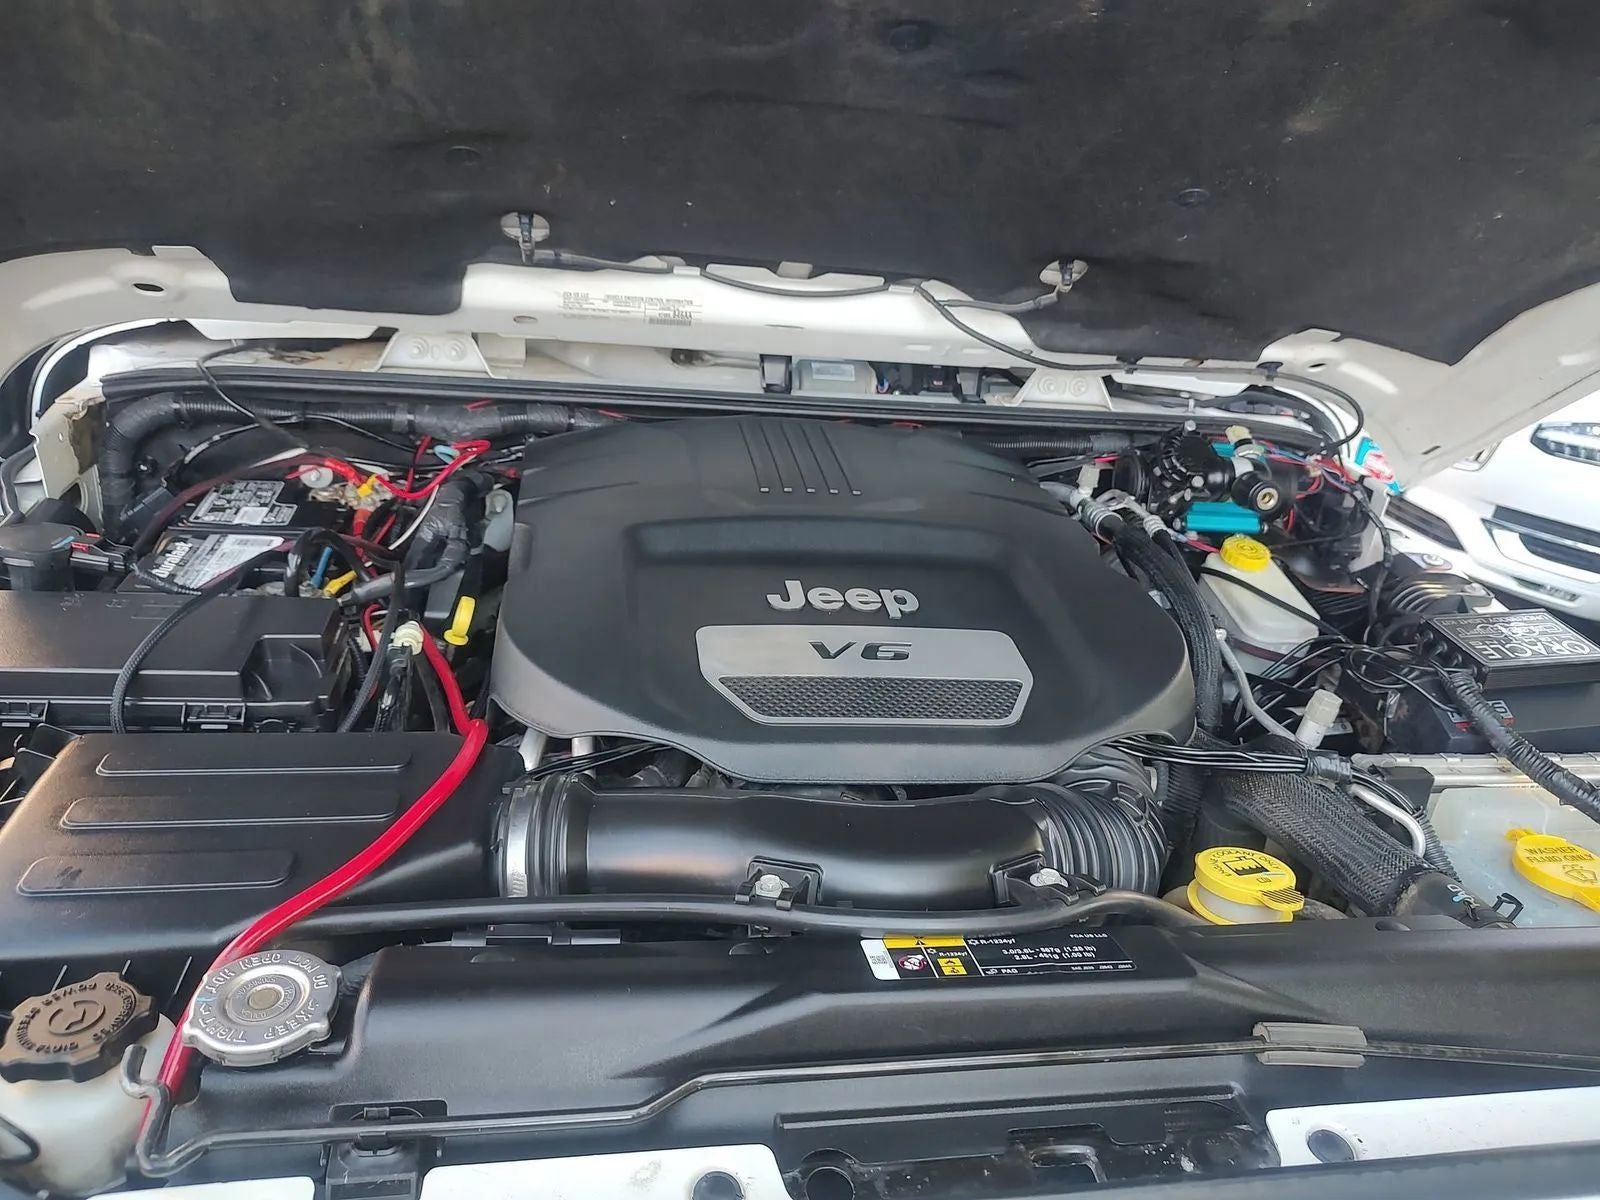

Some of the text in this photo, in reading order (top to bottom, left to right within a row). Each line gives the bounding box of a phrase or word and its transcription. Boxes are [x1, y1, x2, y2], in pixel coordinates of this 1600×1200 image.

[766, 580, 920, 619] Jeep
[808, 640, 912, 661] V6
[1475, 640, 1591, 659] ORACLE
[1212, 849, 1256, 858] COOLANT
[1259, 857, 1281, 870] ONLY
[1525, 855, 1562, 863] FLUID
[239, 953, 281, 970] OPEN
[288, 954, 320, 973] NOT
[205, 968, 235, 994] HOT
[312, 974, 329, 990] DO
[198, 1009, 313, 1043] KEEP TIGHT
